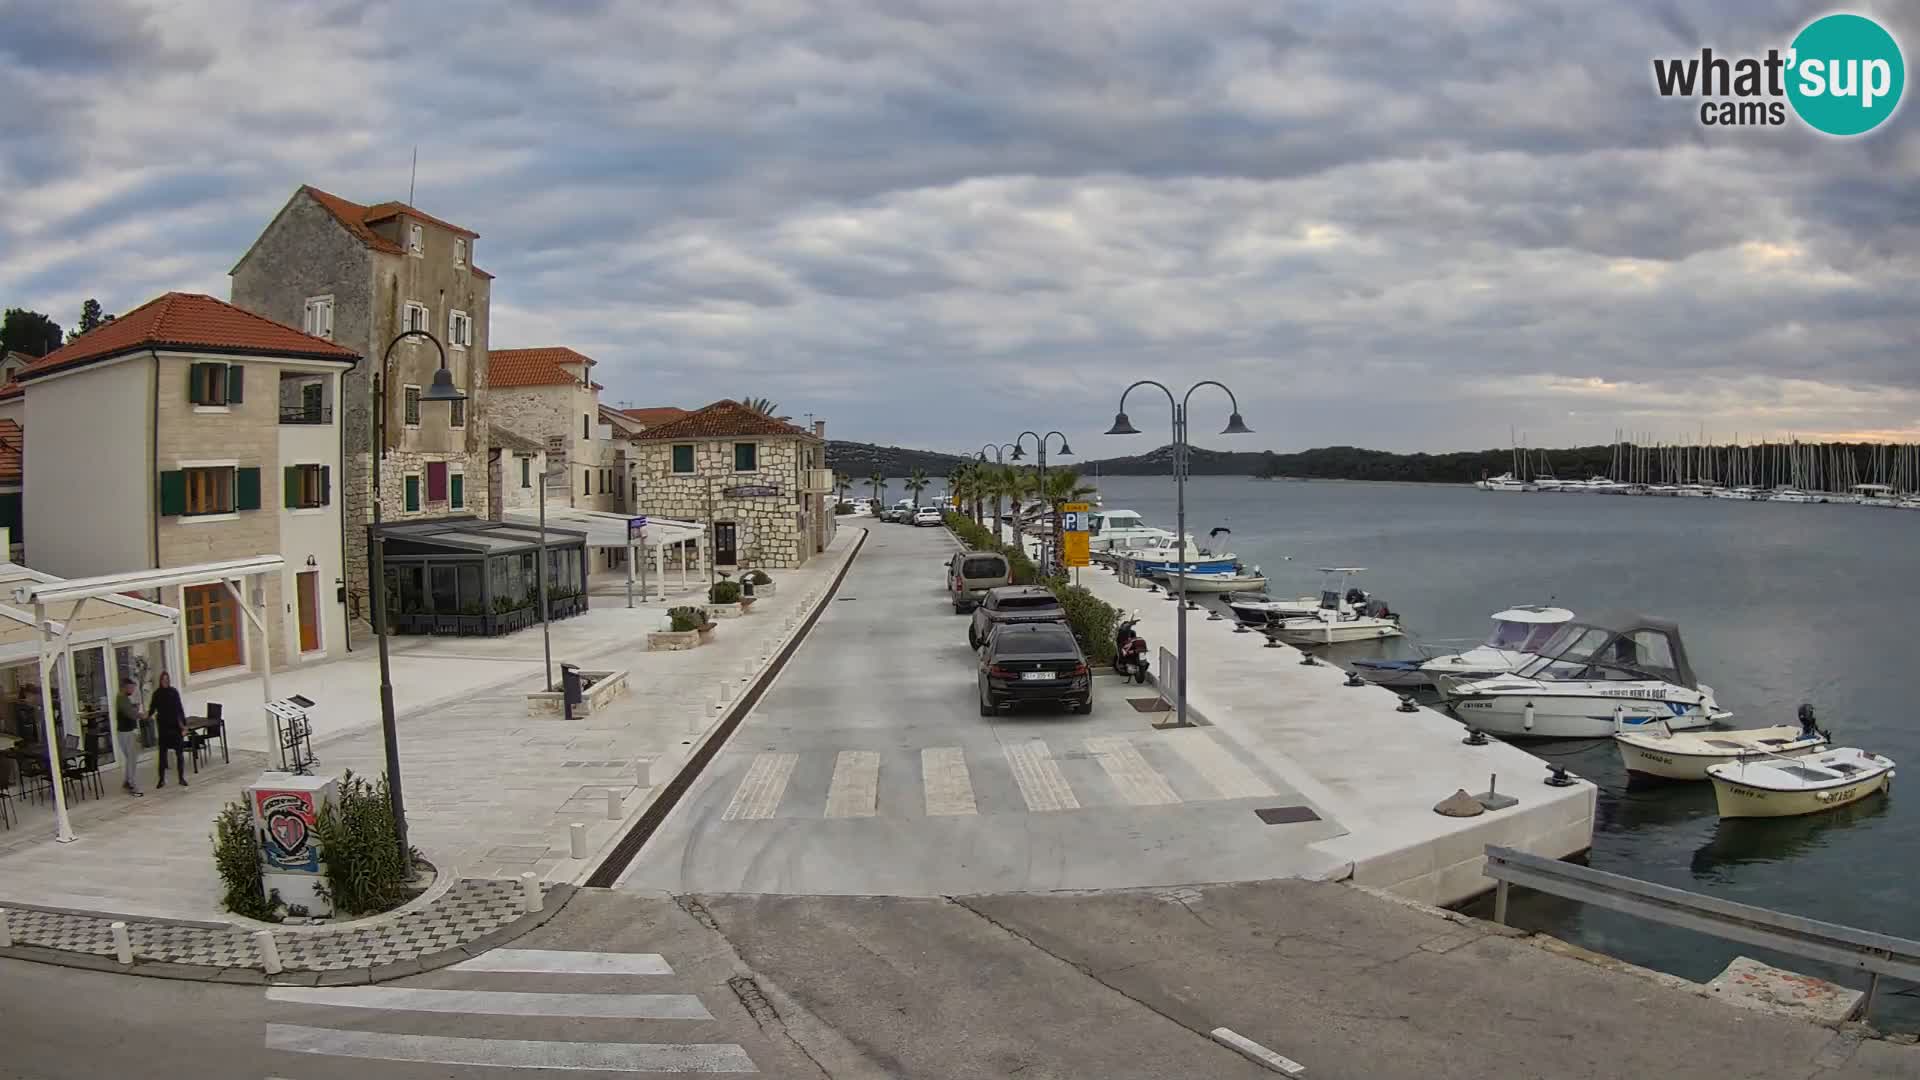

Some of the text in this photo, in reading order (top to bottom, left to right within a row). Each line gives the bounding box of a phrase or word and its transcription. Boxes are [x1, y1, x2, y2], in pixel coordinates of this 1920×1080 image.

[1066, 514, 1076, 529] P
[1630, 689, 1646, 697] RENT
[1652, 689, 1667, 699] BOAT
